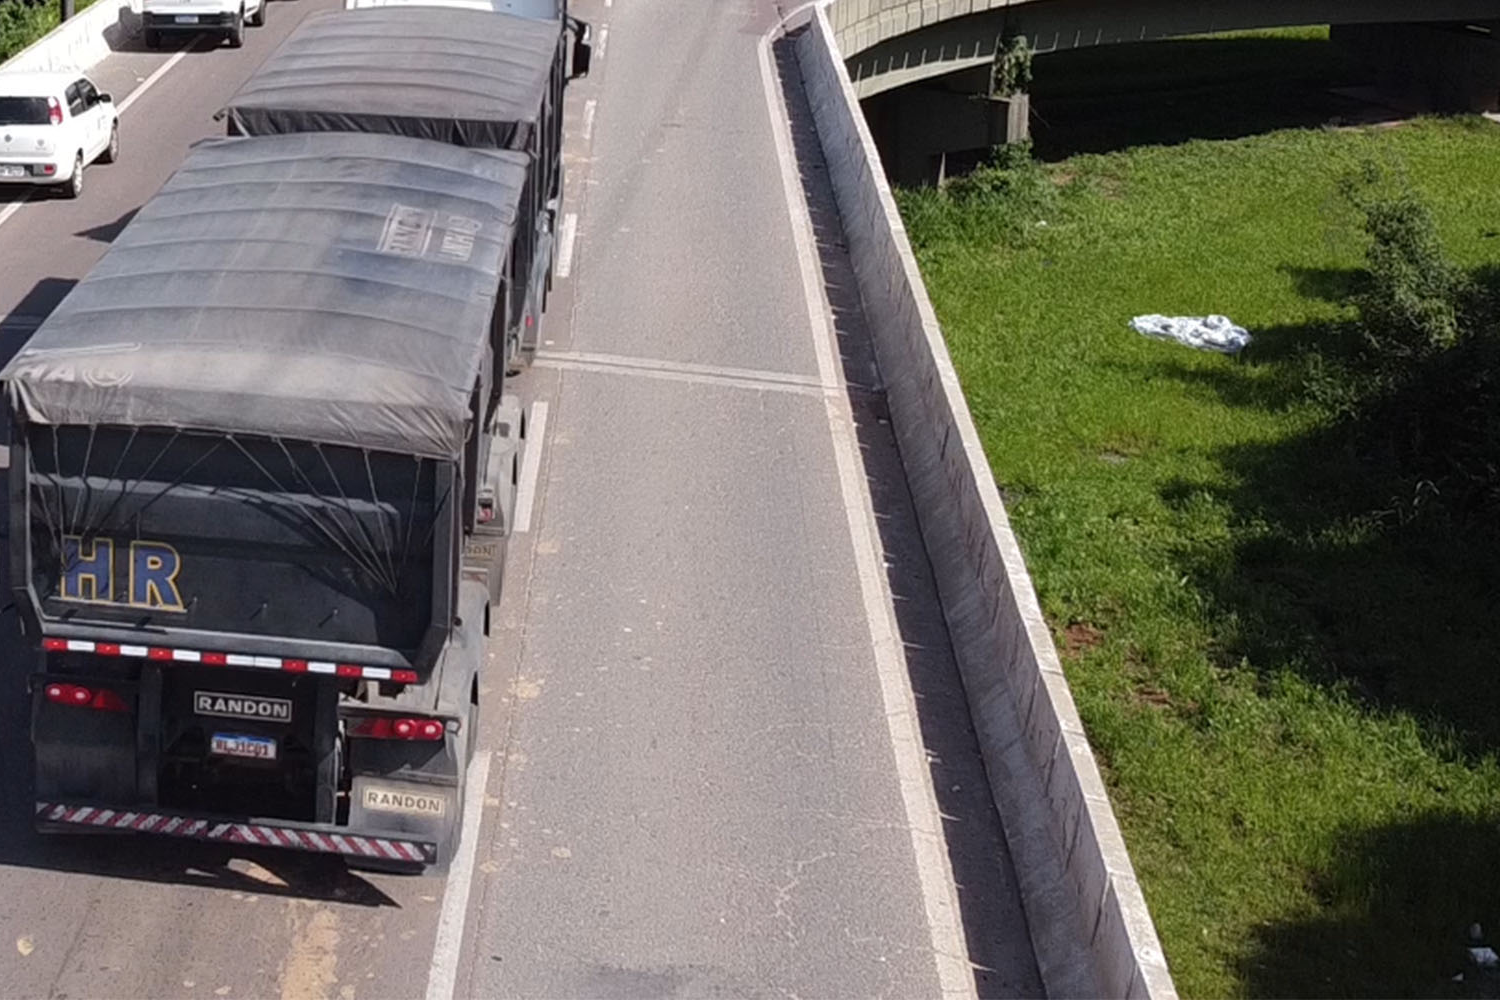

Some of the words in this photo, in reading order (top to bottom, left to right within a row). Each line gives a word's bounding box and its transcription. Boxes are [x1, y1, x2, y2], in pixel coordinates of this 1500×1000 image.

[59, 534, 185, 611] HR
[198, 695, 288, 718] RANDON
[367, 791, 441, 812] RANDON
